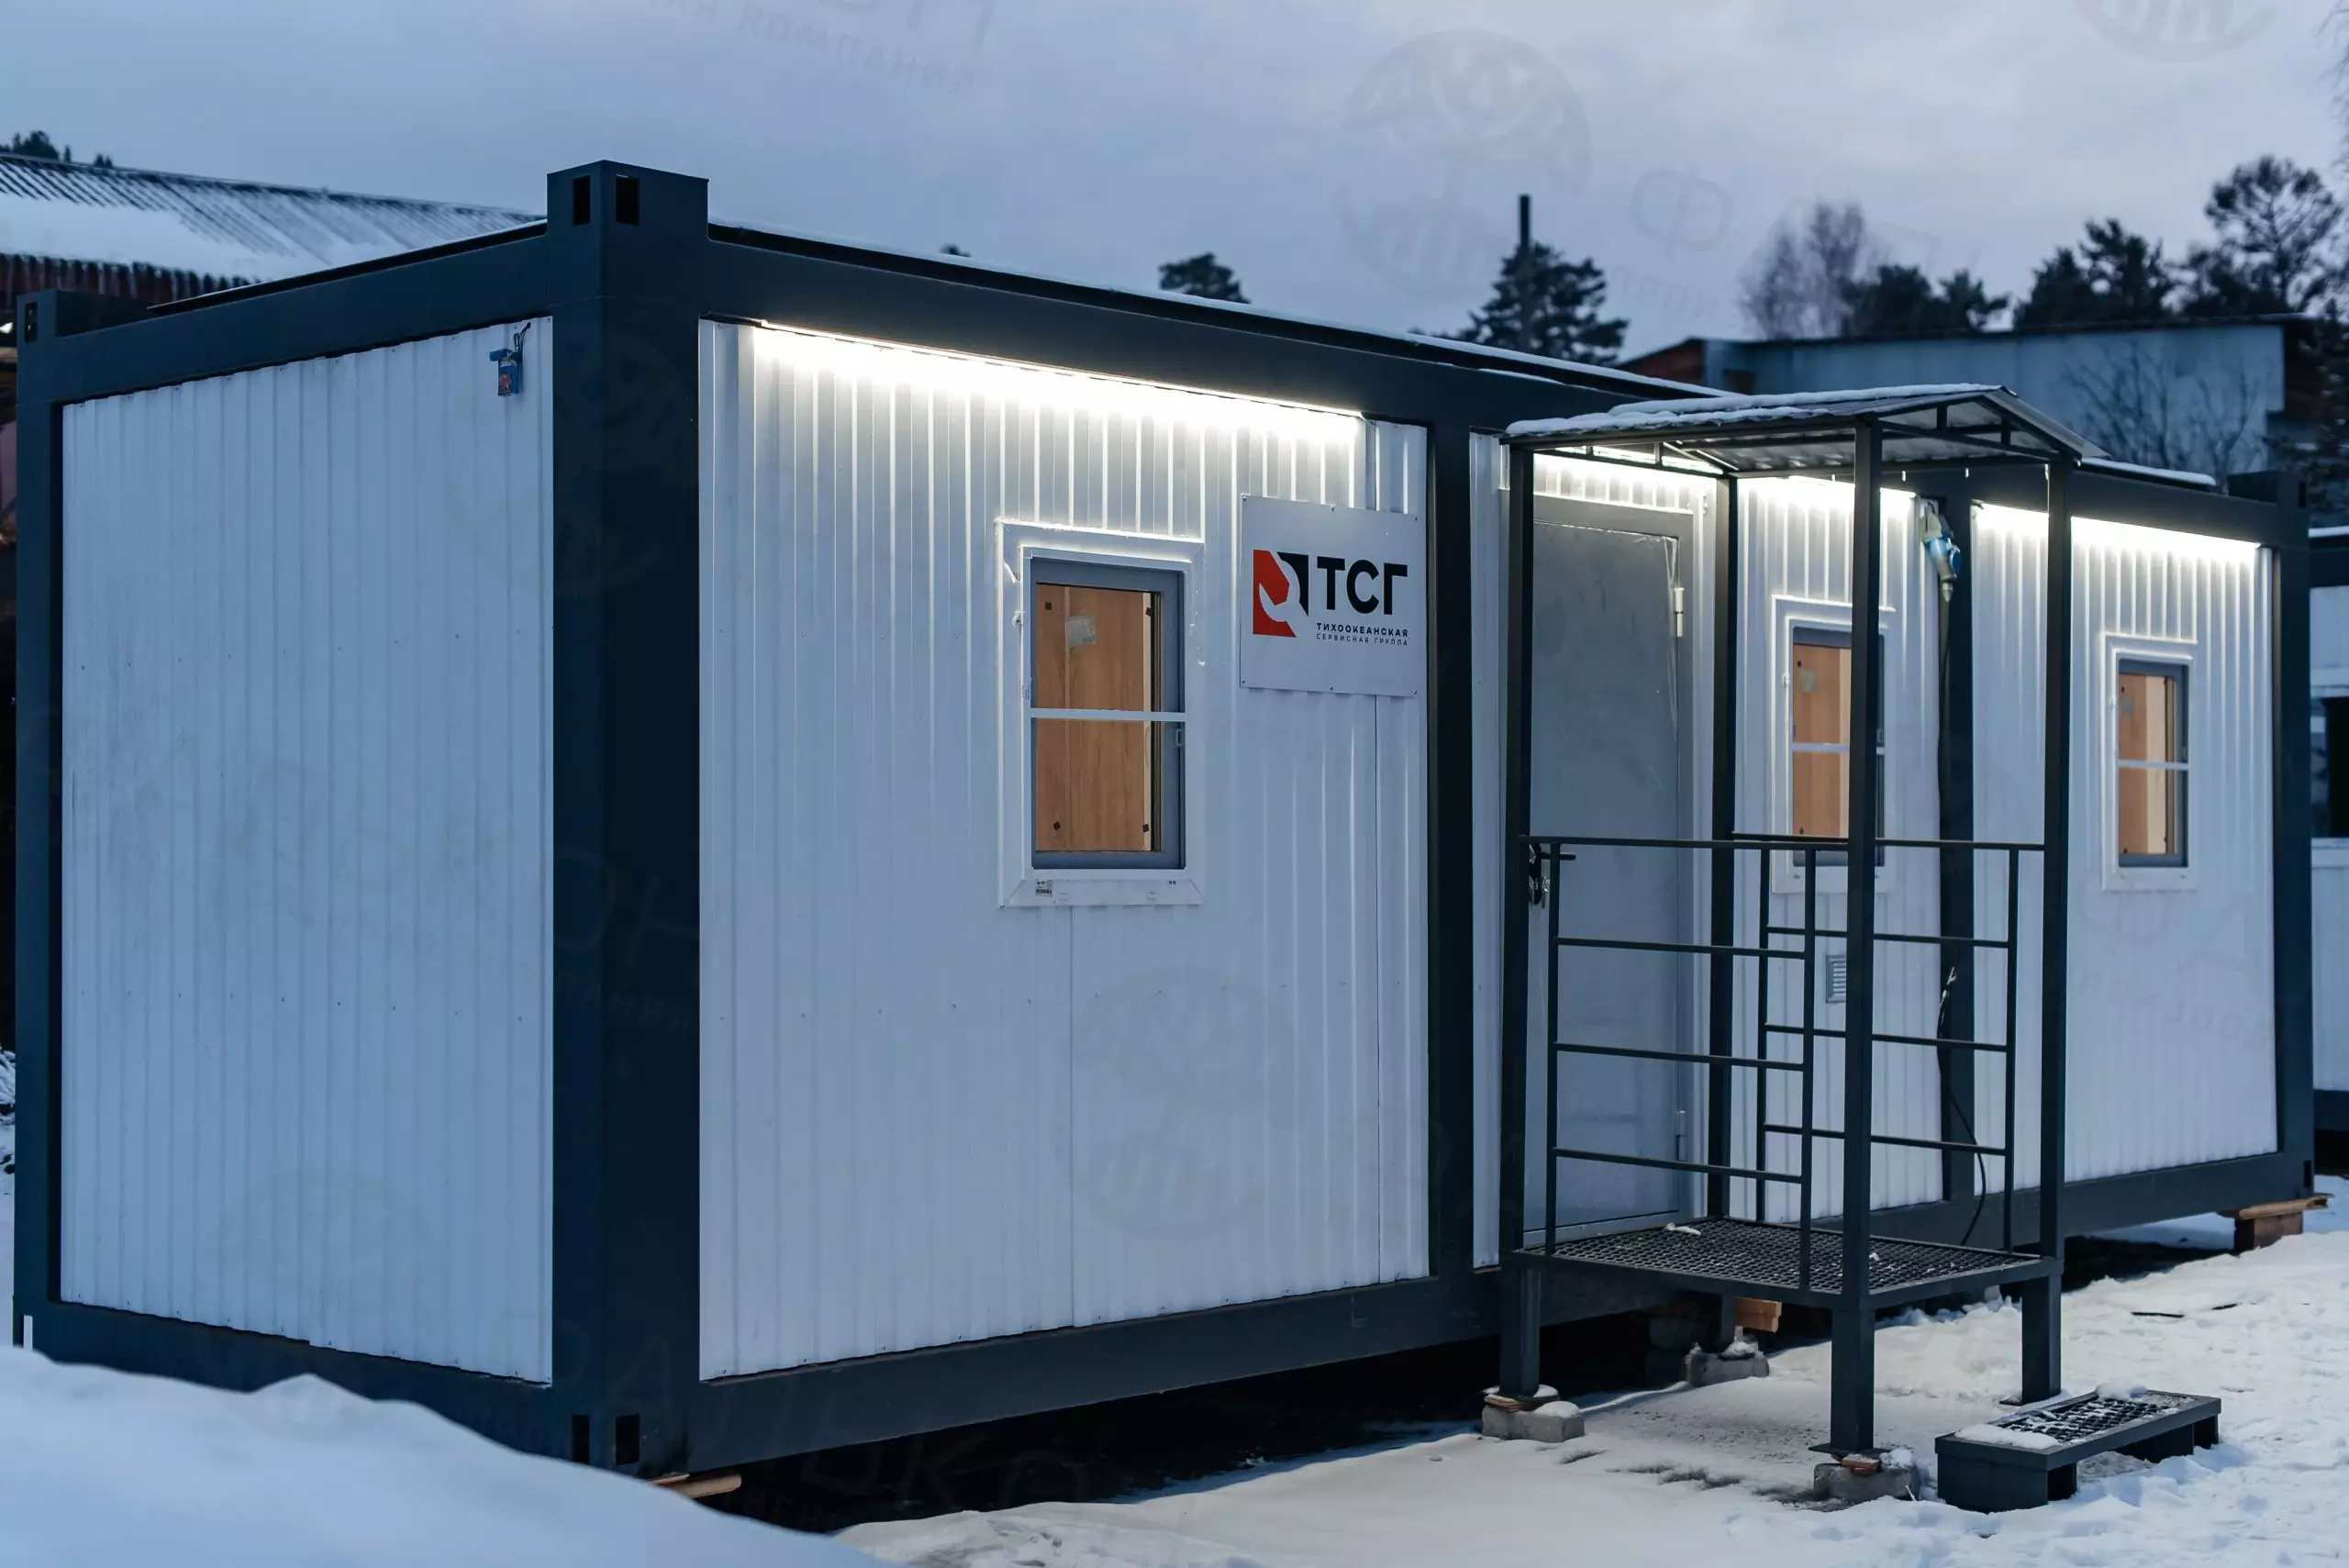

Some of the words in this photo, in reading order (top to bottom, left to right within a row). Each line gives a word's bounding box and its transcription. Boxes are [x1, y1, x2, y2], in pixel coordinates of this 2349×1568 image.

[1317, 555, 1408, 616] ТСГ
[1316, 622, 1408, 638] ТИХООКЕАНСКАЯ
[1316, 633, 1369, 643] СЕРВИСНАЯ
[1374, 637, 1408, 646] ГРУППА
